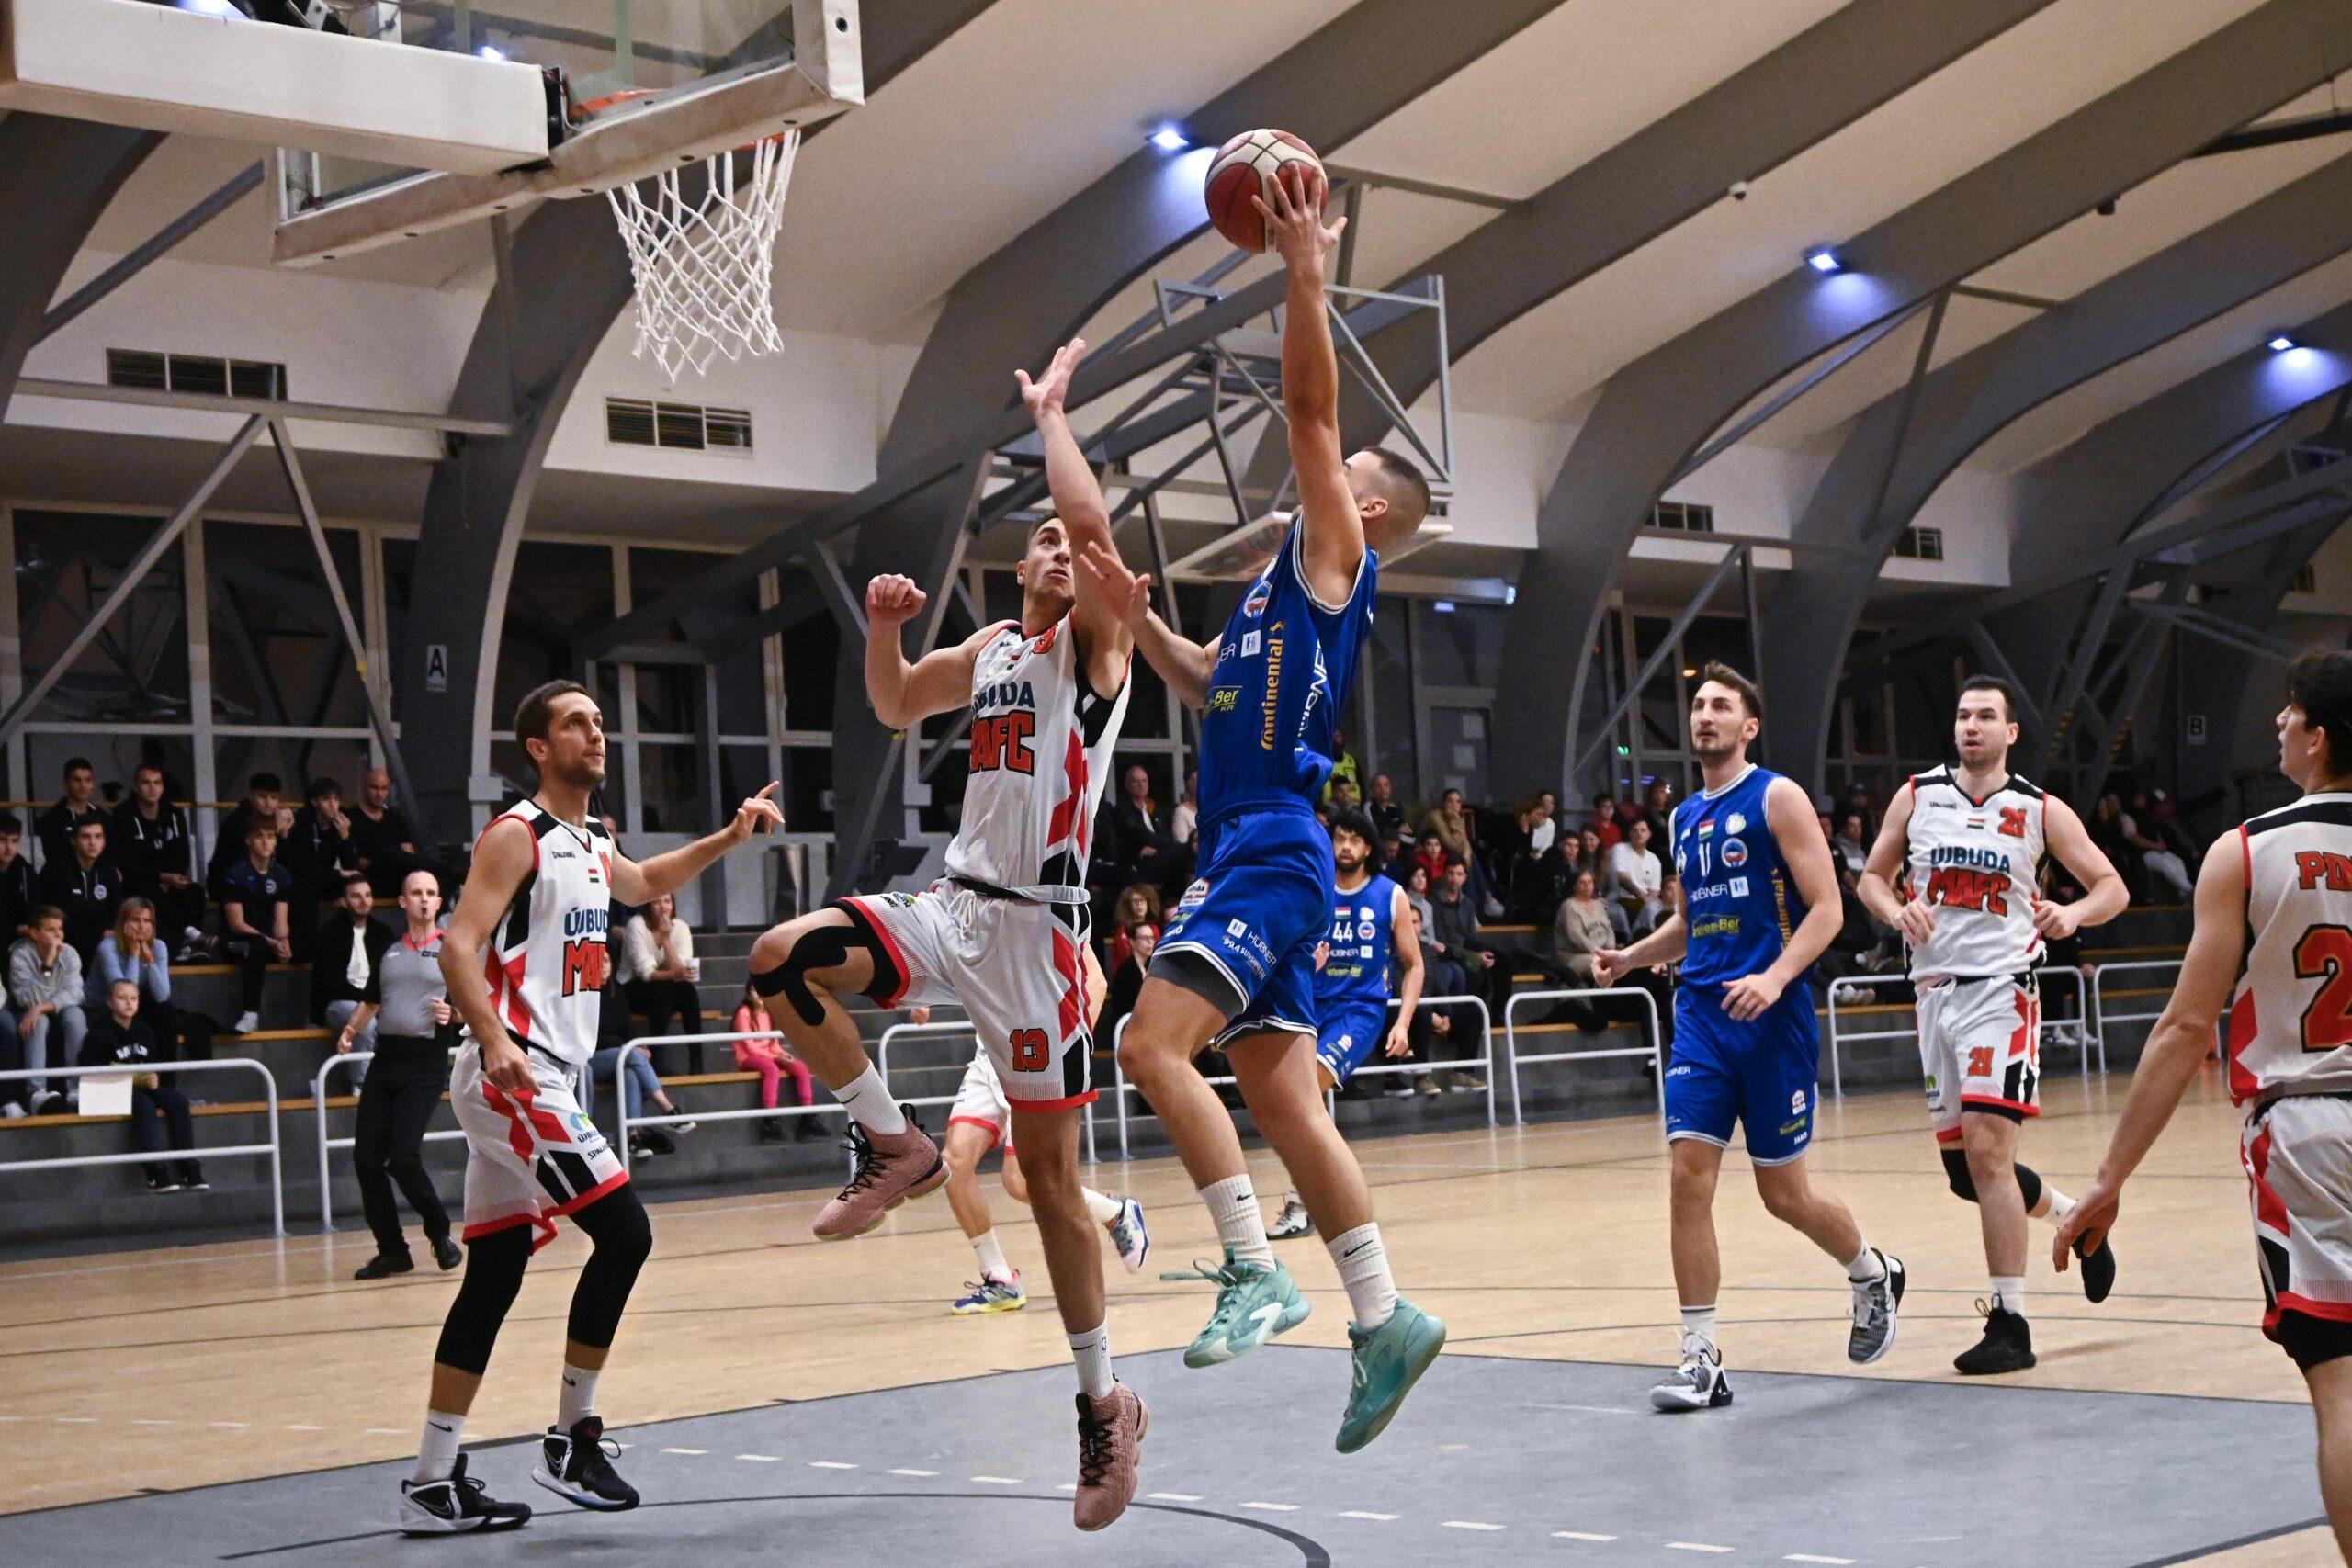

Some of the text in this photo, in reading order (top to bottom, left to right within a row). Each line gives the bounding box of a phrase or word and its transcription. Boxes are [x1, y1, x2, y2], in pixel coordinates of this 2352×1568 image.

[427, 649, 445, 677] A
[972, 681, 1035, 714] BUDA
[1208, 690, 1238, 707] -Ber
[1998, 806, 2027, 838] 21
[1930, 843, 2010, 874] ÚJBUDA
[1928, 866, 2011, 917] MAFC
[564, 907, 609, 937] ÚJBUD
[1332, 920, 1353, 942] 44
[562, 937, 606, 998] MA
[1010, 1028, 1049, 1073] 13
[1967, 1046, 1995, 1077] 21
